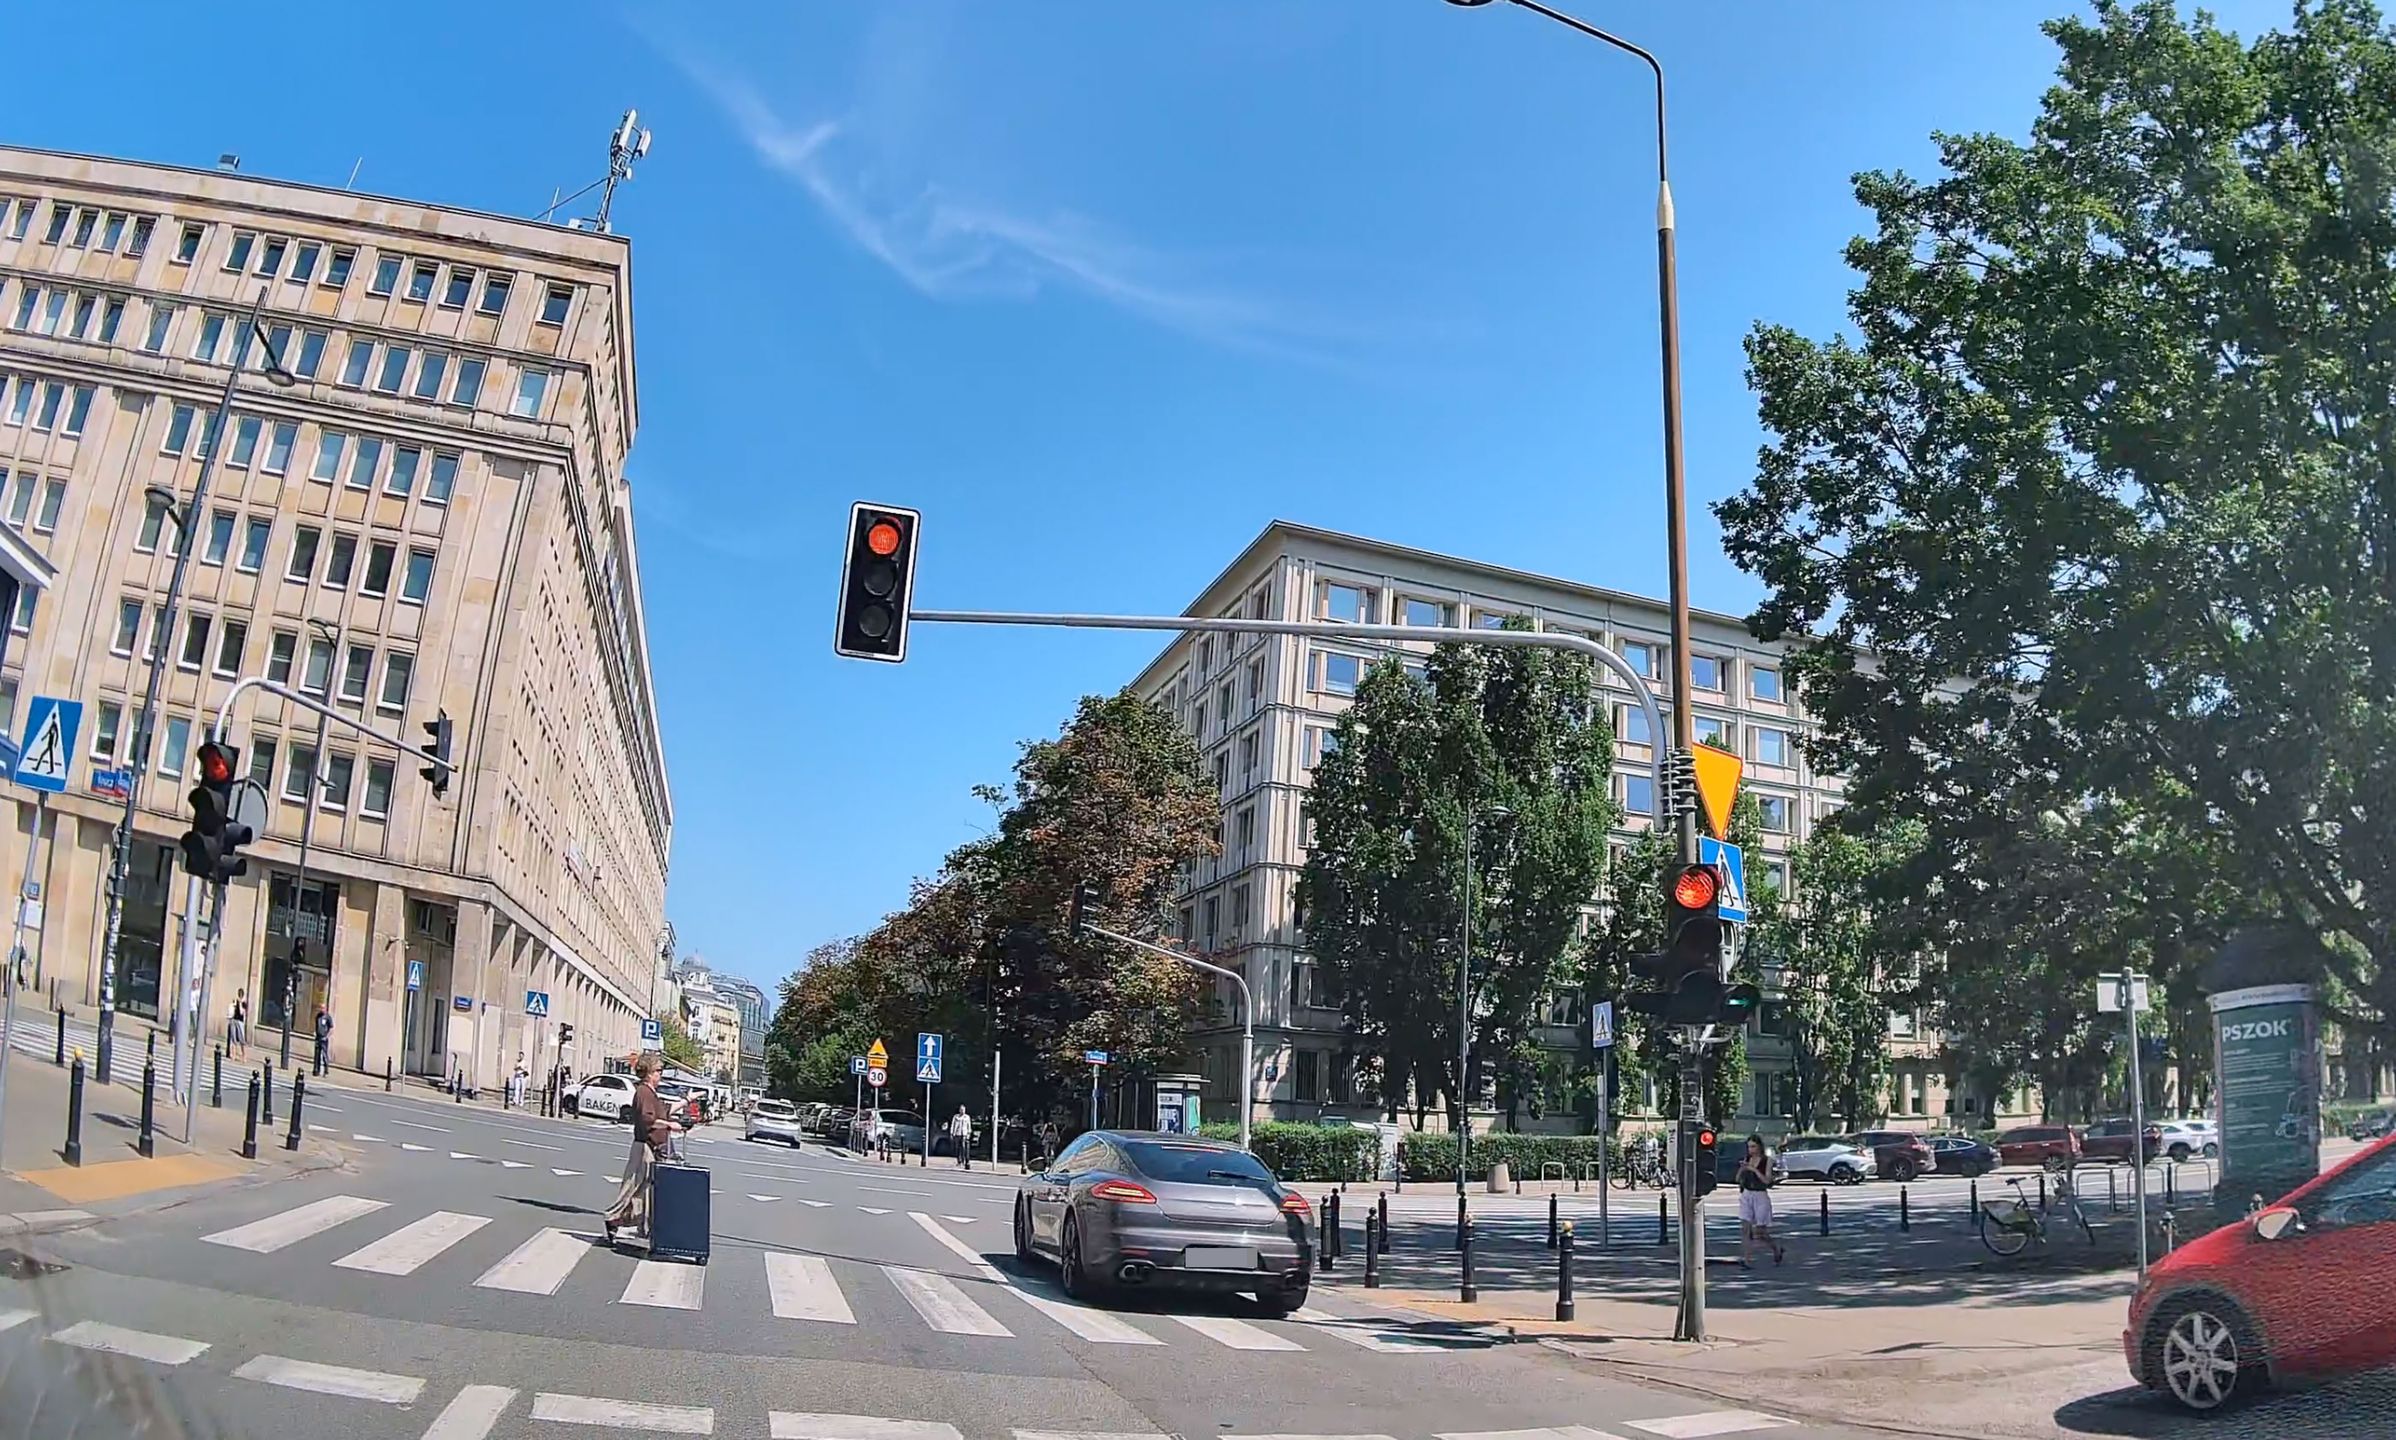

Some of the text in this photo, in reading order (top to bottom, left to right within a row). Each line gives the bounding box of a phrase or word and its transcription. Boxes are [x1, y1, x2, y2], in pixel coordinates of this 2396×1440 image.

[645, 1021, 657, 1037] P
[2222, 1020, 2287, 1041] PSZOK
[855, 1059, 866, 1072] P
[871, 1071, 884, 1082] 30
